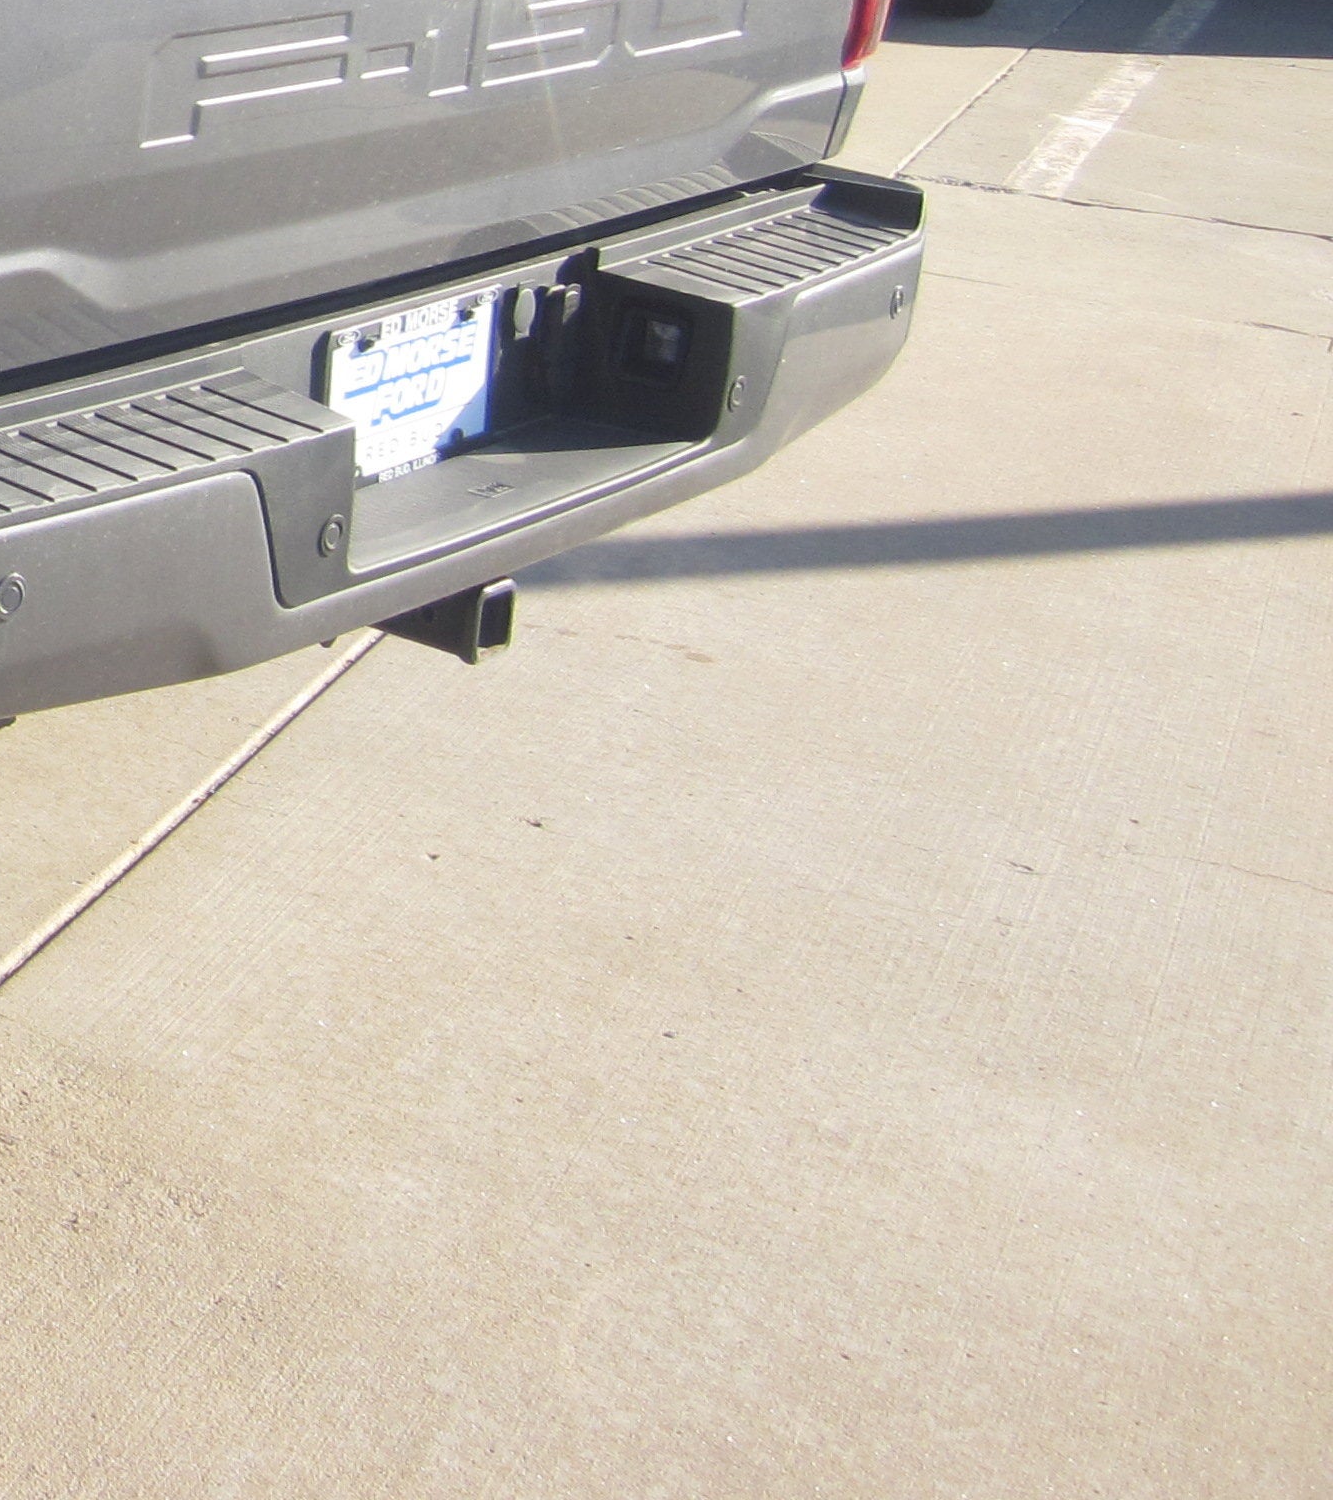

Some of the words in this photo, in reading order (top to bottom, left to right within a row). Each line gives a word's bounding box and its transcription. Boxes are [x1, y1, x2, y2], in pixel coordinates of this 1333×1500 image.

[382, 319, 402, 335] ED
[347, 349, 387, 394] ED
[383, 322, 478, 381] MORSE
[371, 367, 447, 426] FORD
